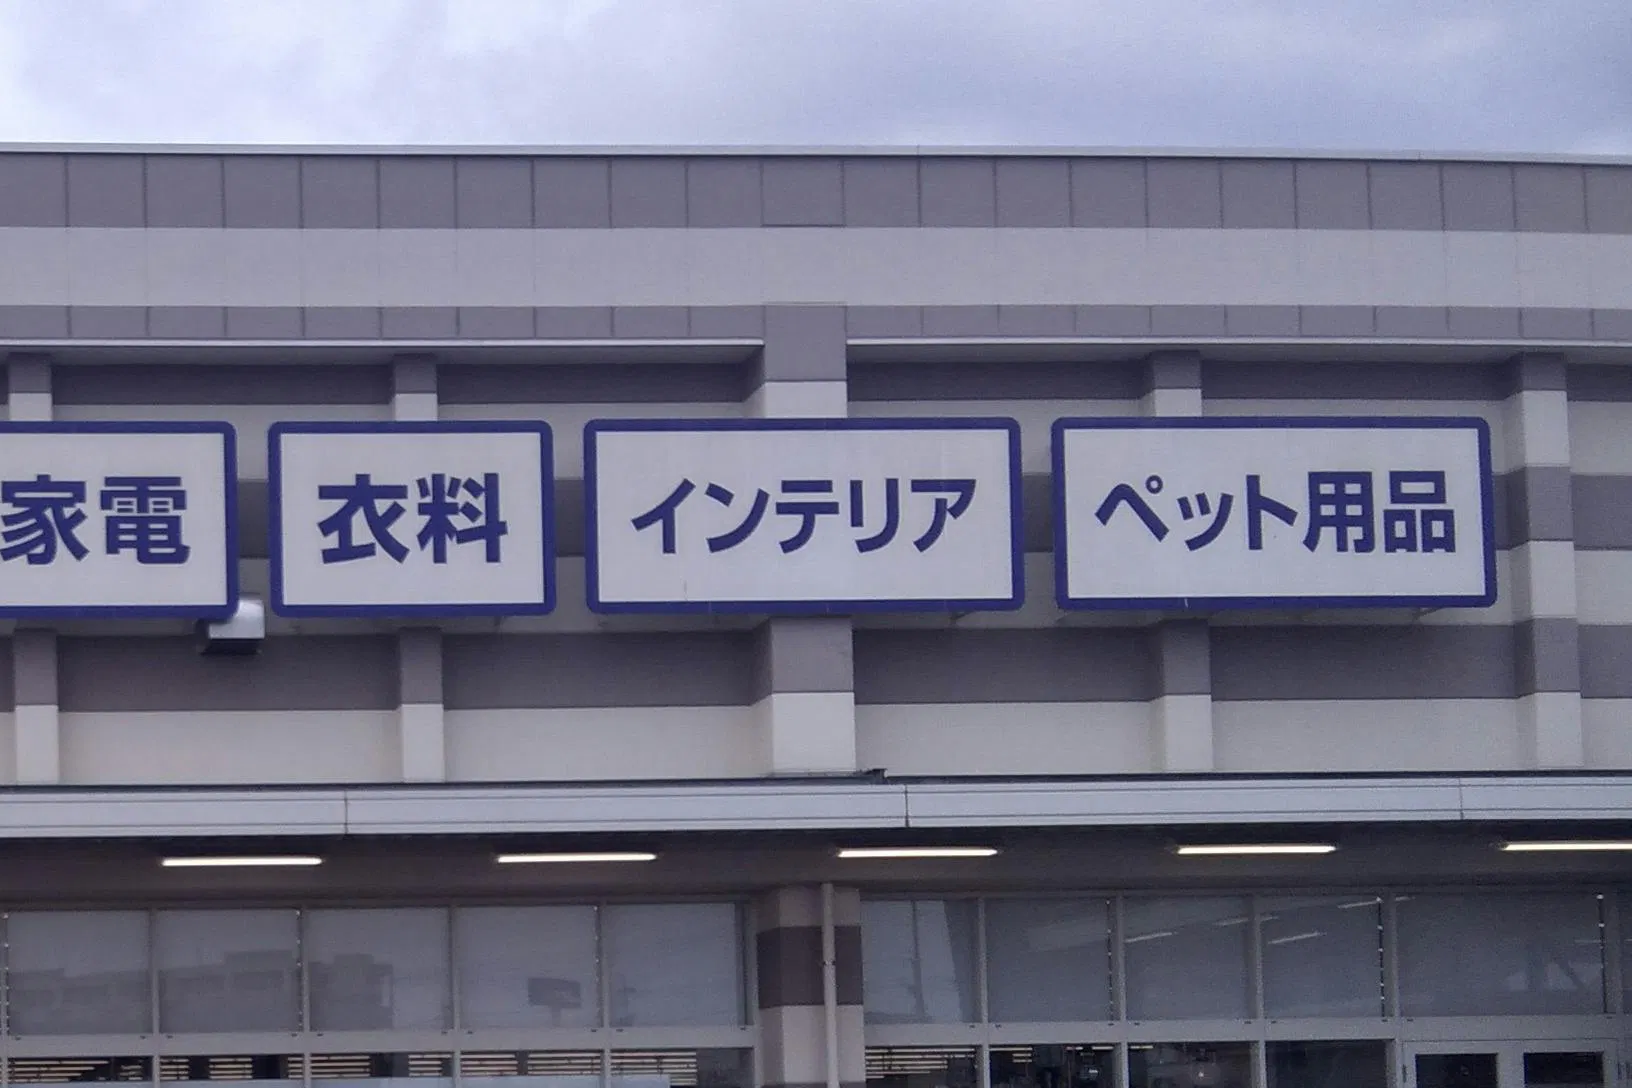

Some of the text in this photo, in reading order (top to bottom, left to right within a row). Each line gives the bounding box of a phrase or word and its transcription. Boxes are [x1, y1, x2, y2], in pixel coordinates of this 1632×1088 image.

[316, 472, 508, 565] 衣料
[630, 476, 977, 554] インテリア
[1093, 469, 1456, 553] ペット用品
